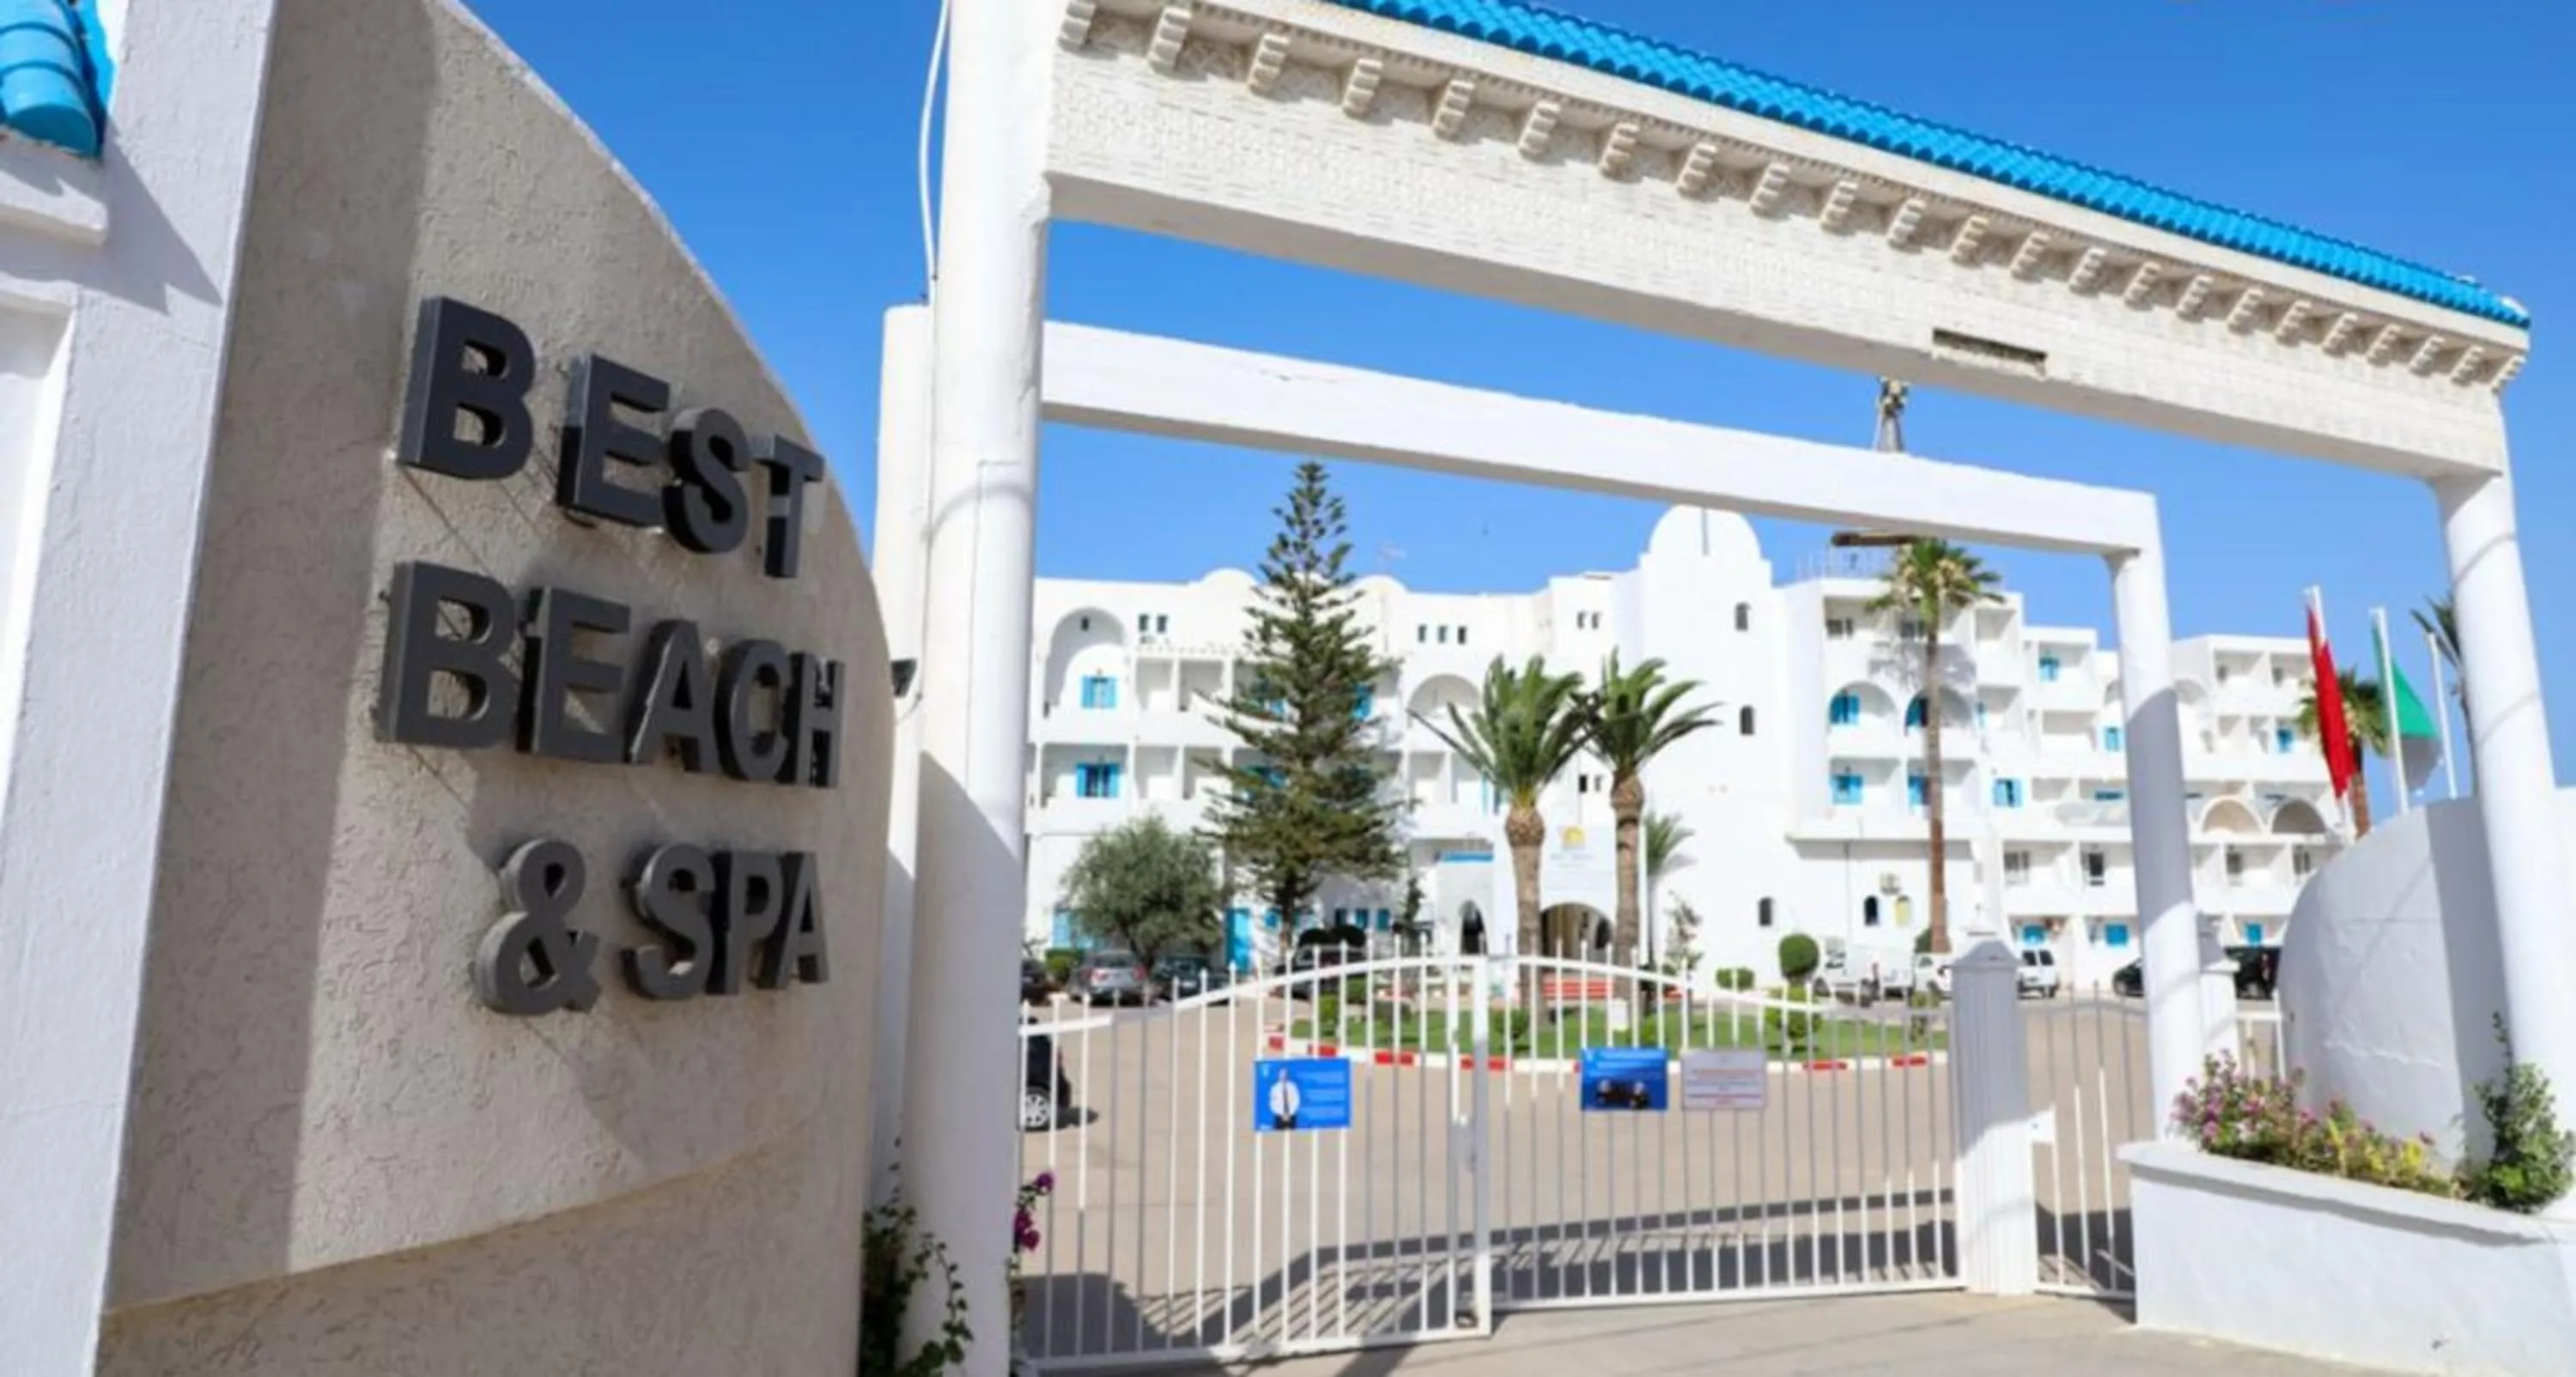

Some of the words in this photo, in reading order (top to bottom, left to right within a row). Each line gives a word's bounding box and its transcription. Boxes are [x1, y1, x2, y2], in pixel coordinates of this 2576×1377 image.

[398, 295, 824, 579] BEST
[376, 561, 846, 788] BEACH
[476, 838, 600, 1015] &
[621, 841, 829, 1000] SPA
